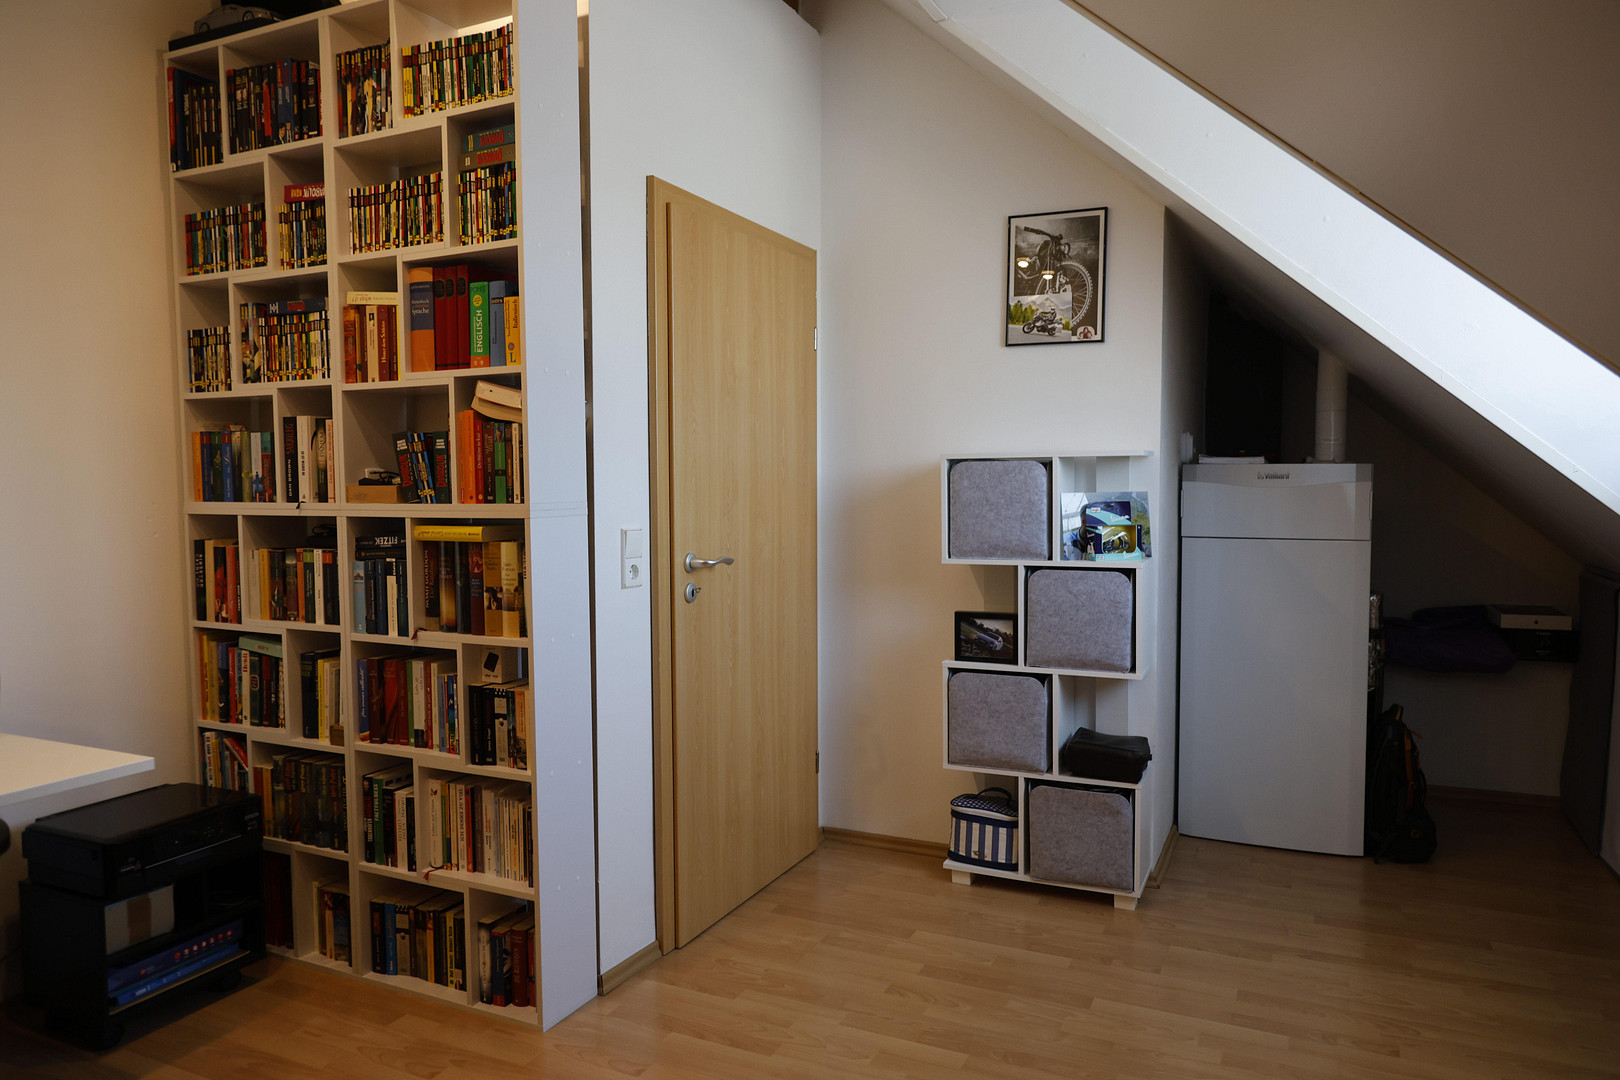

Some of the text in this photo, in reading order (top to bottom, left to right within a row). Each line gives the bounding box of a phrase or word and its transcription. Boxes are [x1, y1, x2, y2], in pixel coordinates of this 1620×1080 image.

[476, 309, 484, 353] ENGLISCH
[285, 423, 295, 454] SAKRILEG
[398, 454, 414, 487] DIABOLIK
[435, 454, 448, 488] DIABOLIK
[374, 536, 398, 545] FITZEK
